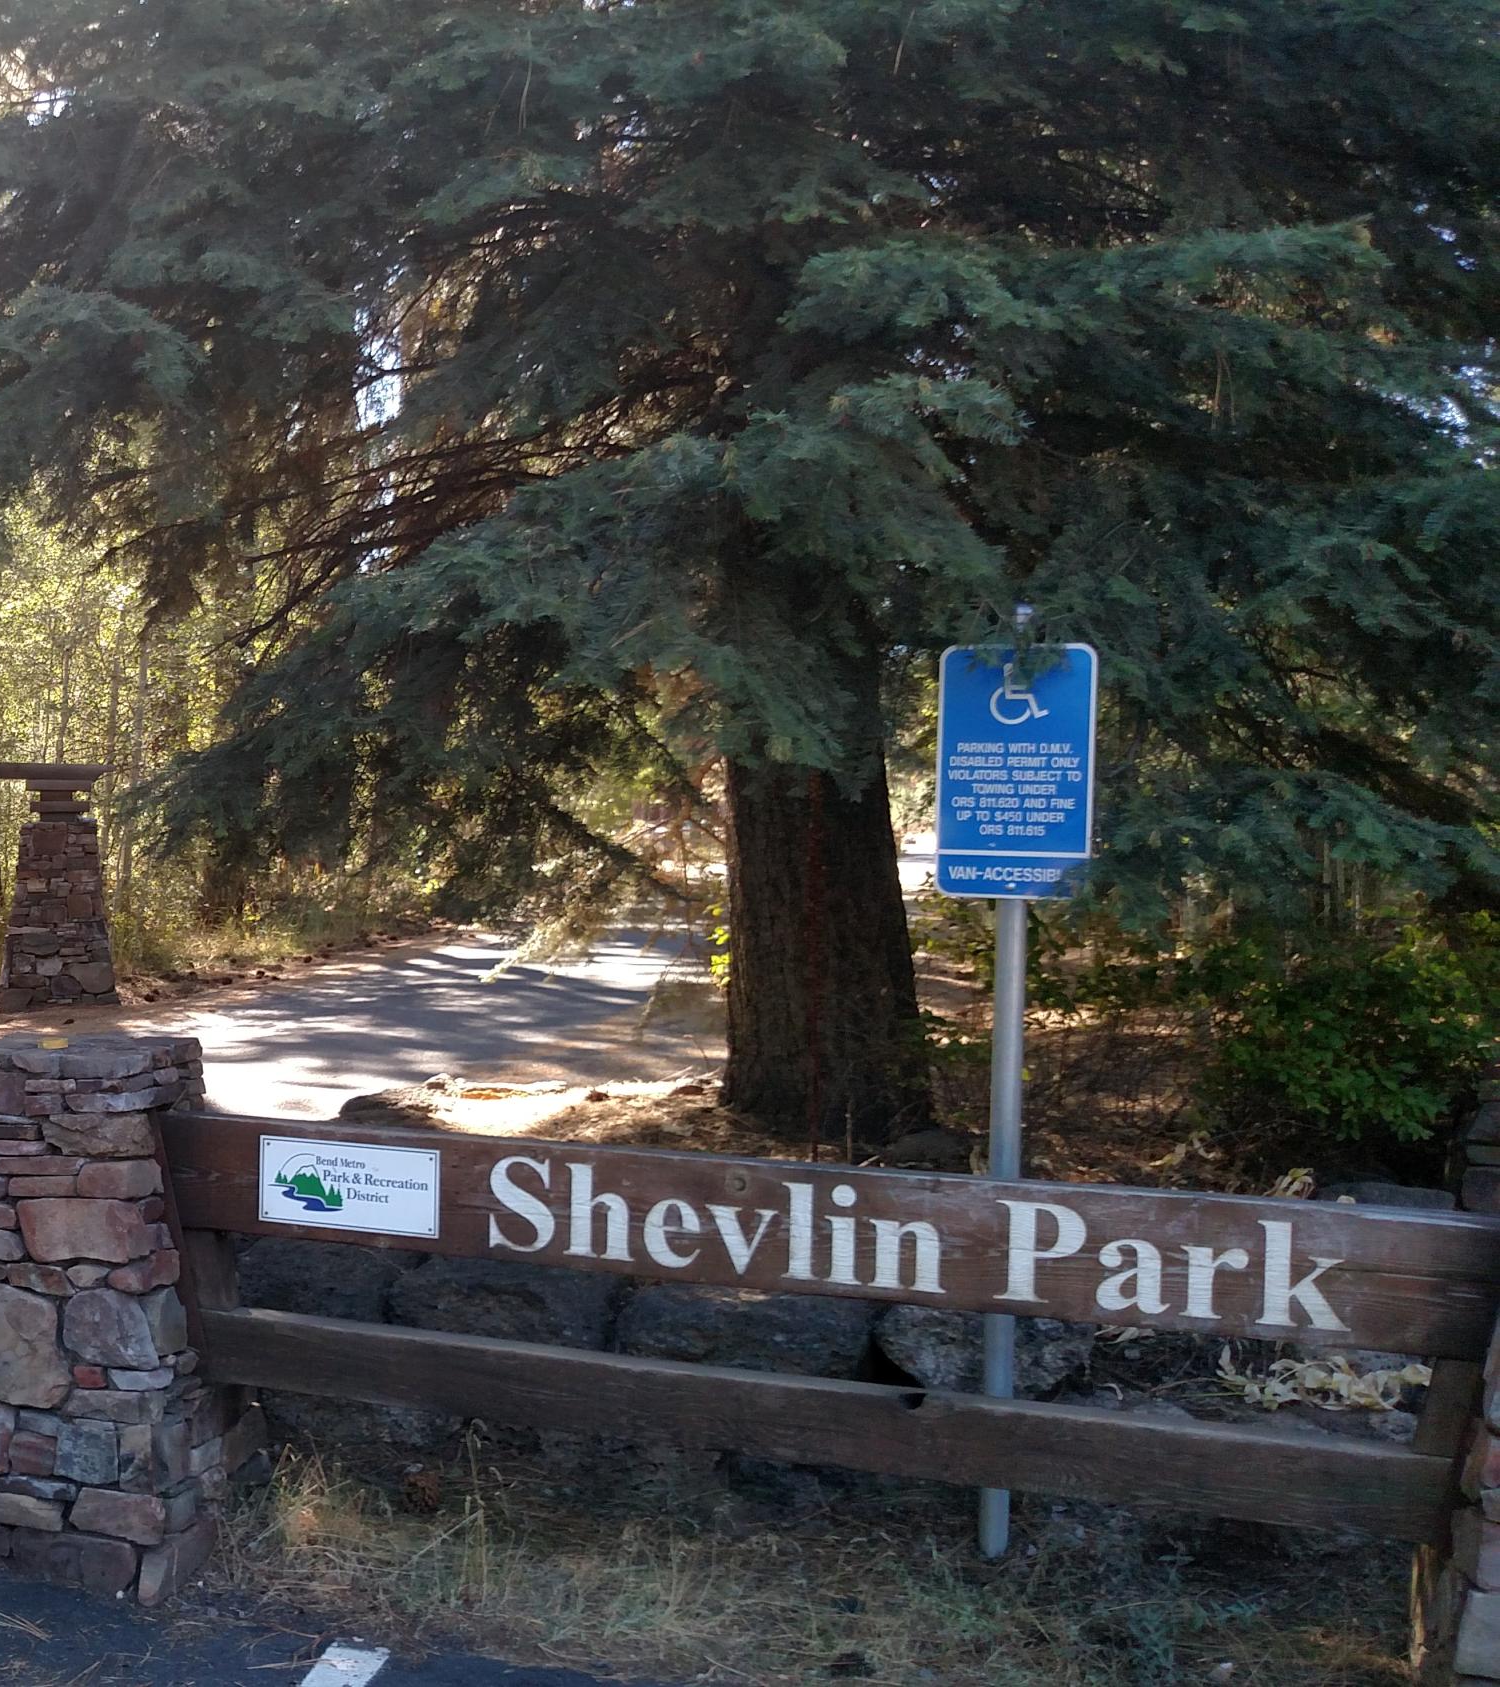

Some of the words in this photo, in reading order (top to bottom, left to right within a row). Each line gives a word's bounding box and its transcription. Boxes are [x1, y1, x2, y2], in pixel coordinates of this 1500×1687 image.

[957, 742, 1004, 754] PARKING
[1009, 743, 1036, 754] WITH
[949, 756, 1004, 767] DISABLED
[1007, 756, 1048, 768] PERMIT
[1050, 757, 1080, 768] ONLY
[948, 769, 1008, 781] VIOLATORS
[1011, 770, 1062, 781] SUBJECT
[1067, 771, 1082, 782] TO
[972, 783, 1014, 794] TOWING
[1018, 784, 1057, 795] UNDER
[951, 796, 975, 807] ORS
[979, 797, 1019, 808] 811.620
[1023, 798, 1047, 809] AND
[1050, 798, 1076, 809] FINE
[956, 810, 972, 821] UP
[975, 810, 990, 821] TO
[994, 811, 1022, 822] $450
[1026, 812, 1065, 823] UNDER
[979, 824, 1004, 835] ORS
[1007, 825, 1045, 836] 811.615
[948, 866, 1061, 882] VAN-ACCESSIB
[315, 1155, 338, 1167] Bend
[340, 1157, 366, 1169] Metro
[323, 1169, 350, 1184] Park
[352, 1173, 362, 1184] &
[364, 1173, 429, 1191] Recreation
[346, 1187, 389, 1204] District
[488, 1154, 946, 1294] Shevlin
[994, 1199, 1352, 1333] Park
